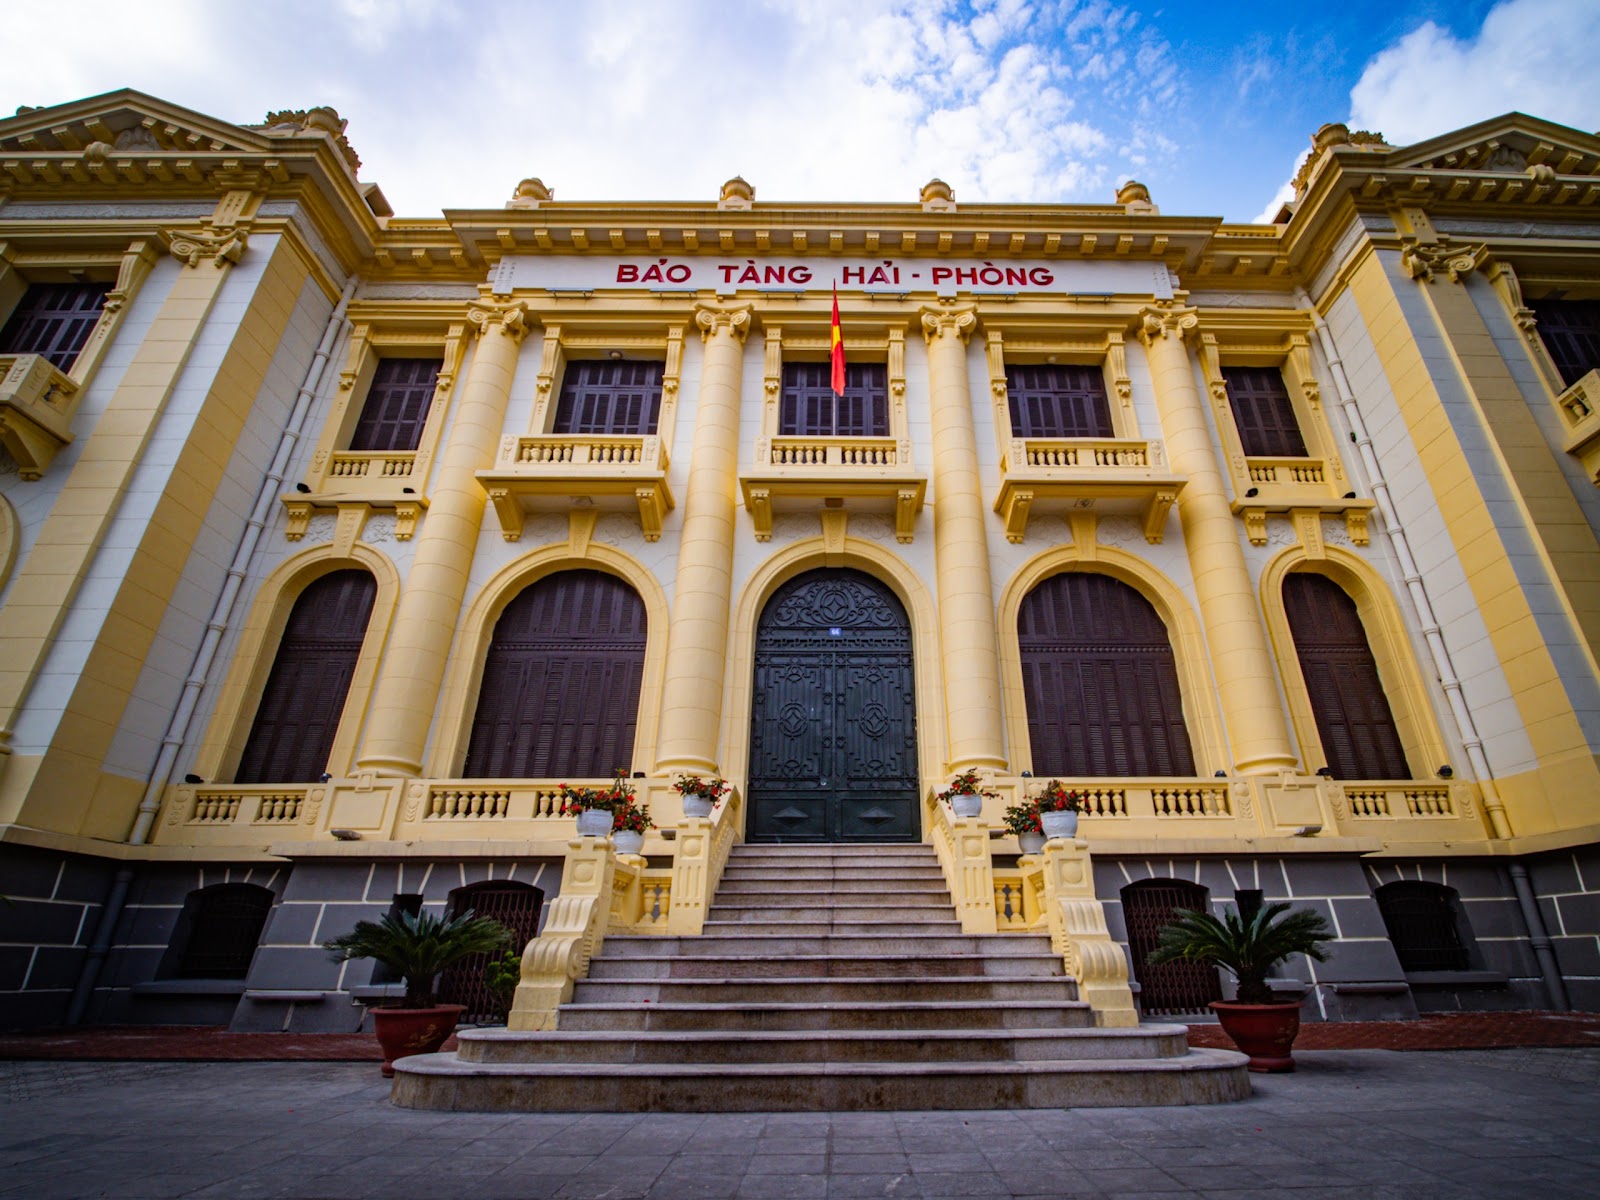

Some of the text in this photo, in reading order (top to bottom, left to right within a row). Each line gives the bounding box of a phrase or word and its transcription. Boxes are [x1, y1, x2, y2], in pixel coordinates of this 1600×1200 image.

[616, 258, 692, 284] BẢO
[718, 260, 813, 285] TÀNG
[842, 261, 901, 286] HẢI
[931, 262, 1055, 287] PHÒNG
